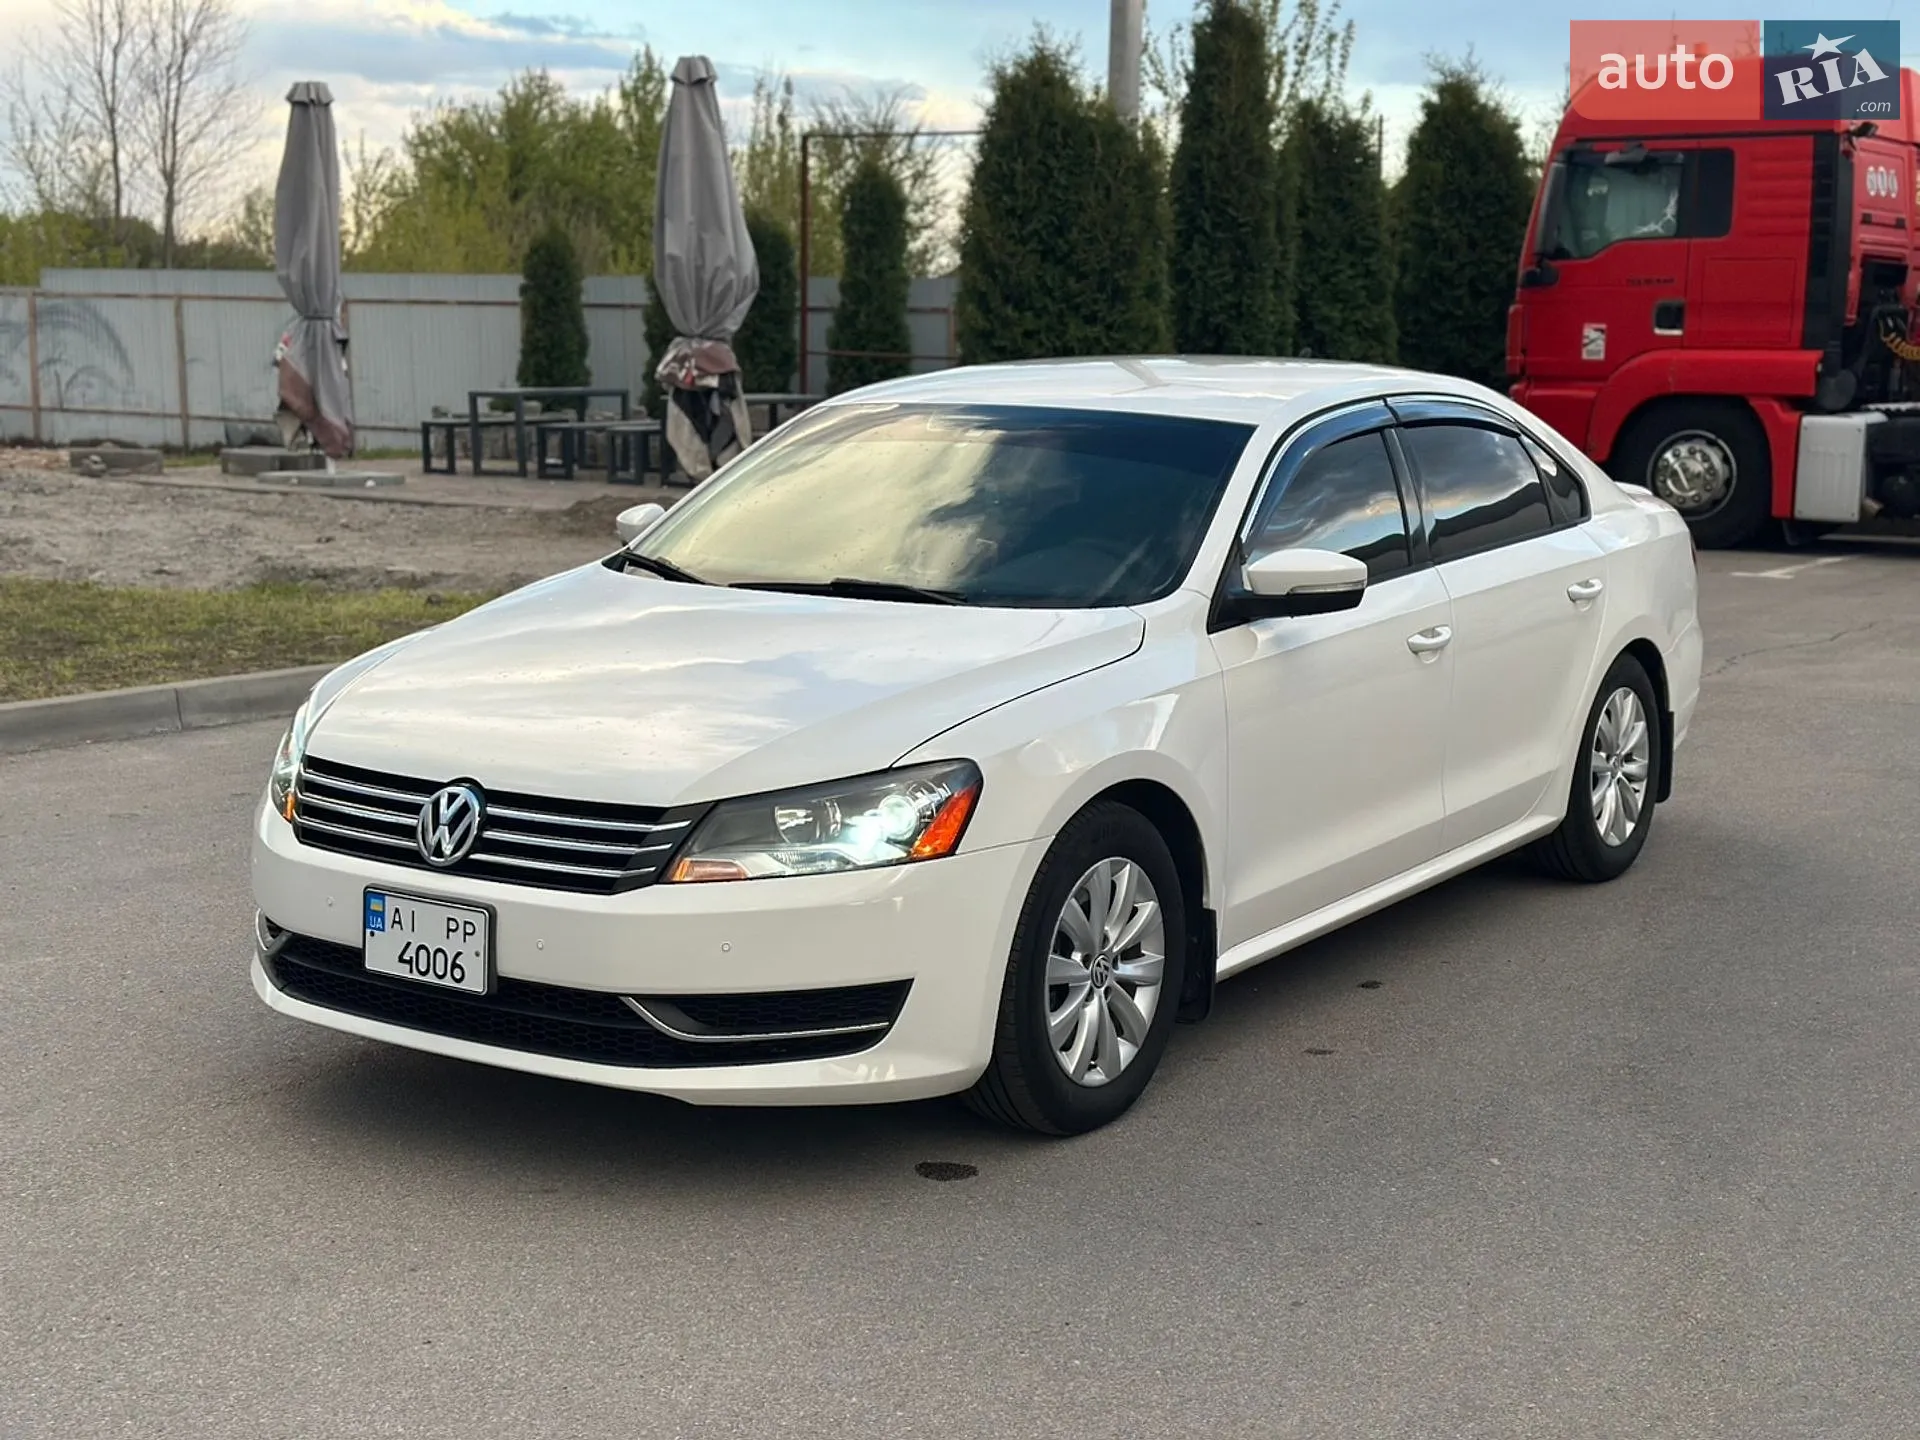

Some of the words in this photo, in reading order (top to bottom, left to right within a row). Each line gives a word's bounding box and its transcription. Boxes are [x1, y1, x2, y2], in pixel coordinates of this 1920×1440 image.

[369, 915, 383, 930] UA
[391, 907, 415, 932] AI
[446, 916, 476, 943] PP
[398, 941, 465, 983] 4006
